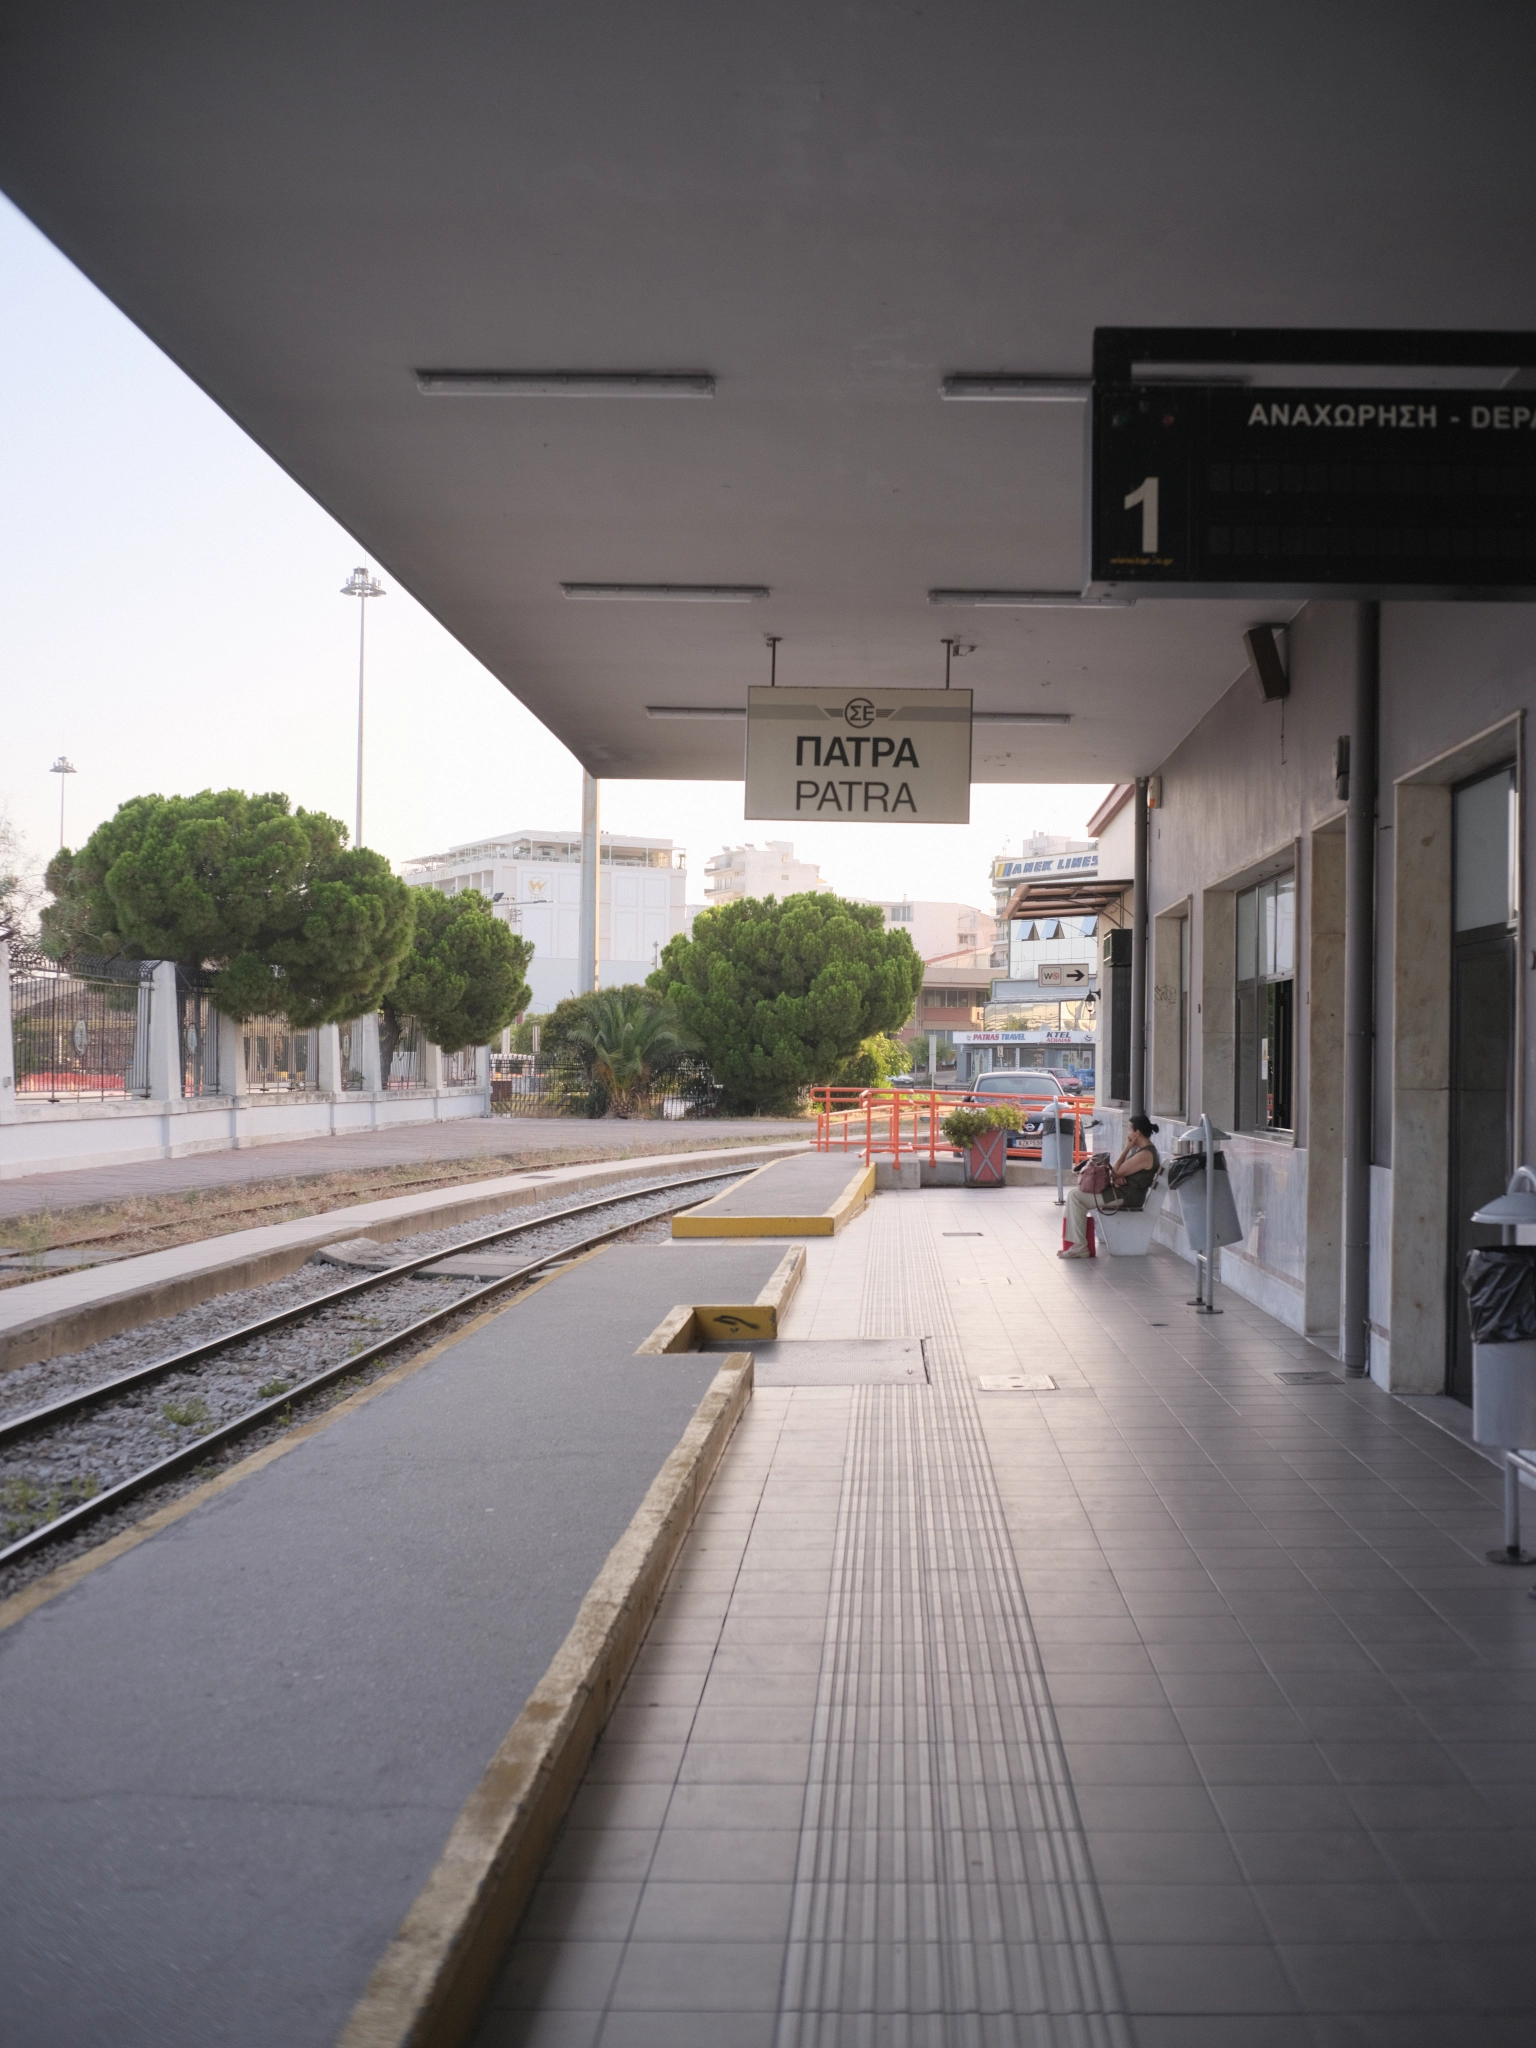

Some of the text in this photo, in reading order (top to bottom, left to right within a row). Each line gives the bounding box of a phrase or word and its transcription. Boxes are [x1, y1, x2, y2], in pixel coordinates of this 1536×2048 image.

[1248, 403, 1437, 428] ΑΝΑΧΩΡΗΣΗ
[1471, 405, 1536, 430] DEP
[1123, 476, 1159, 554] 1
[796, 736, 919, 768] ΠΑΤΡΑ
[796, 780, 917, 813] PATRA
[1012, 856, 1098, 874] ANEK LINES
